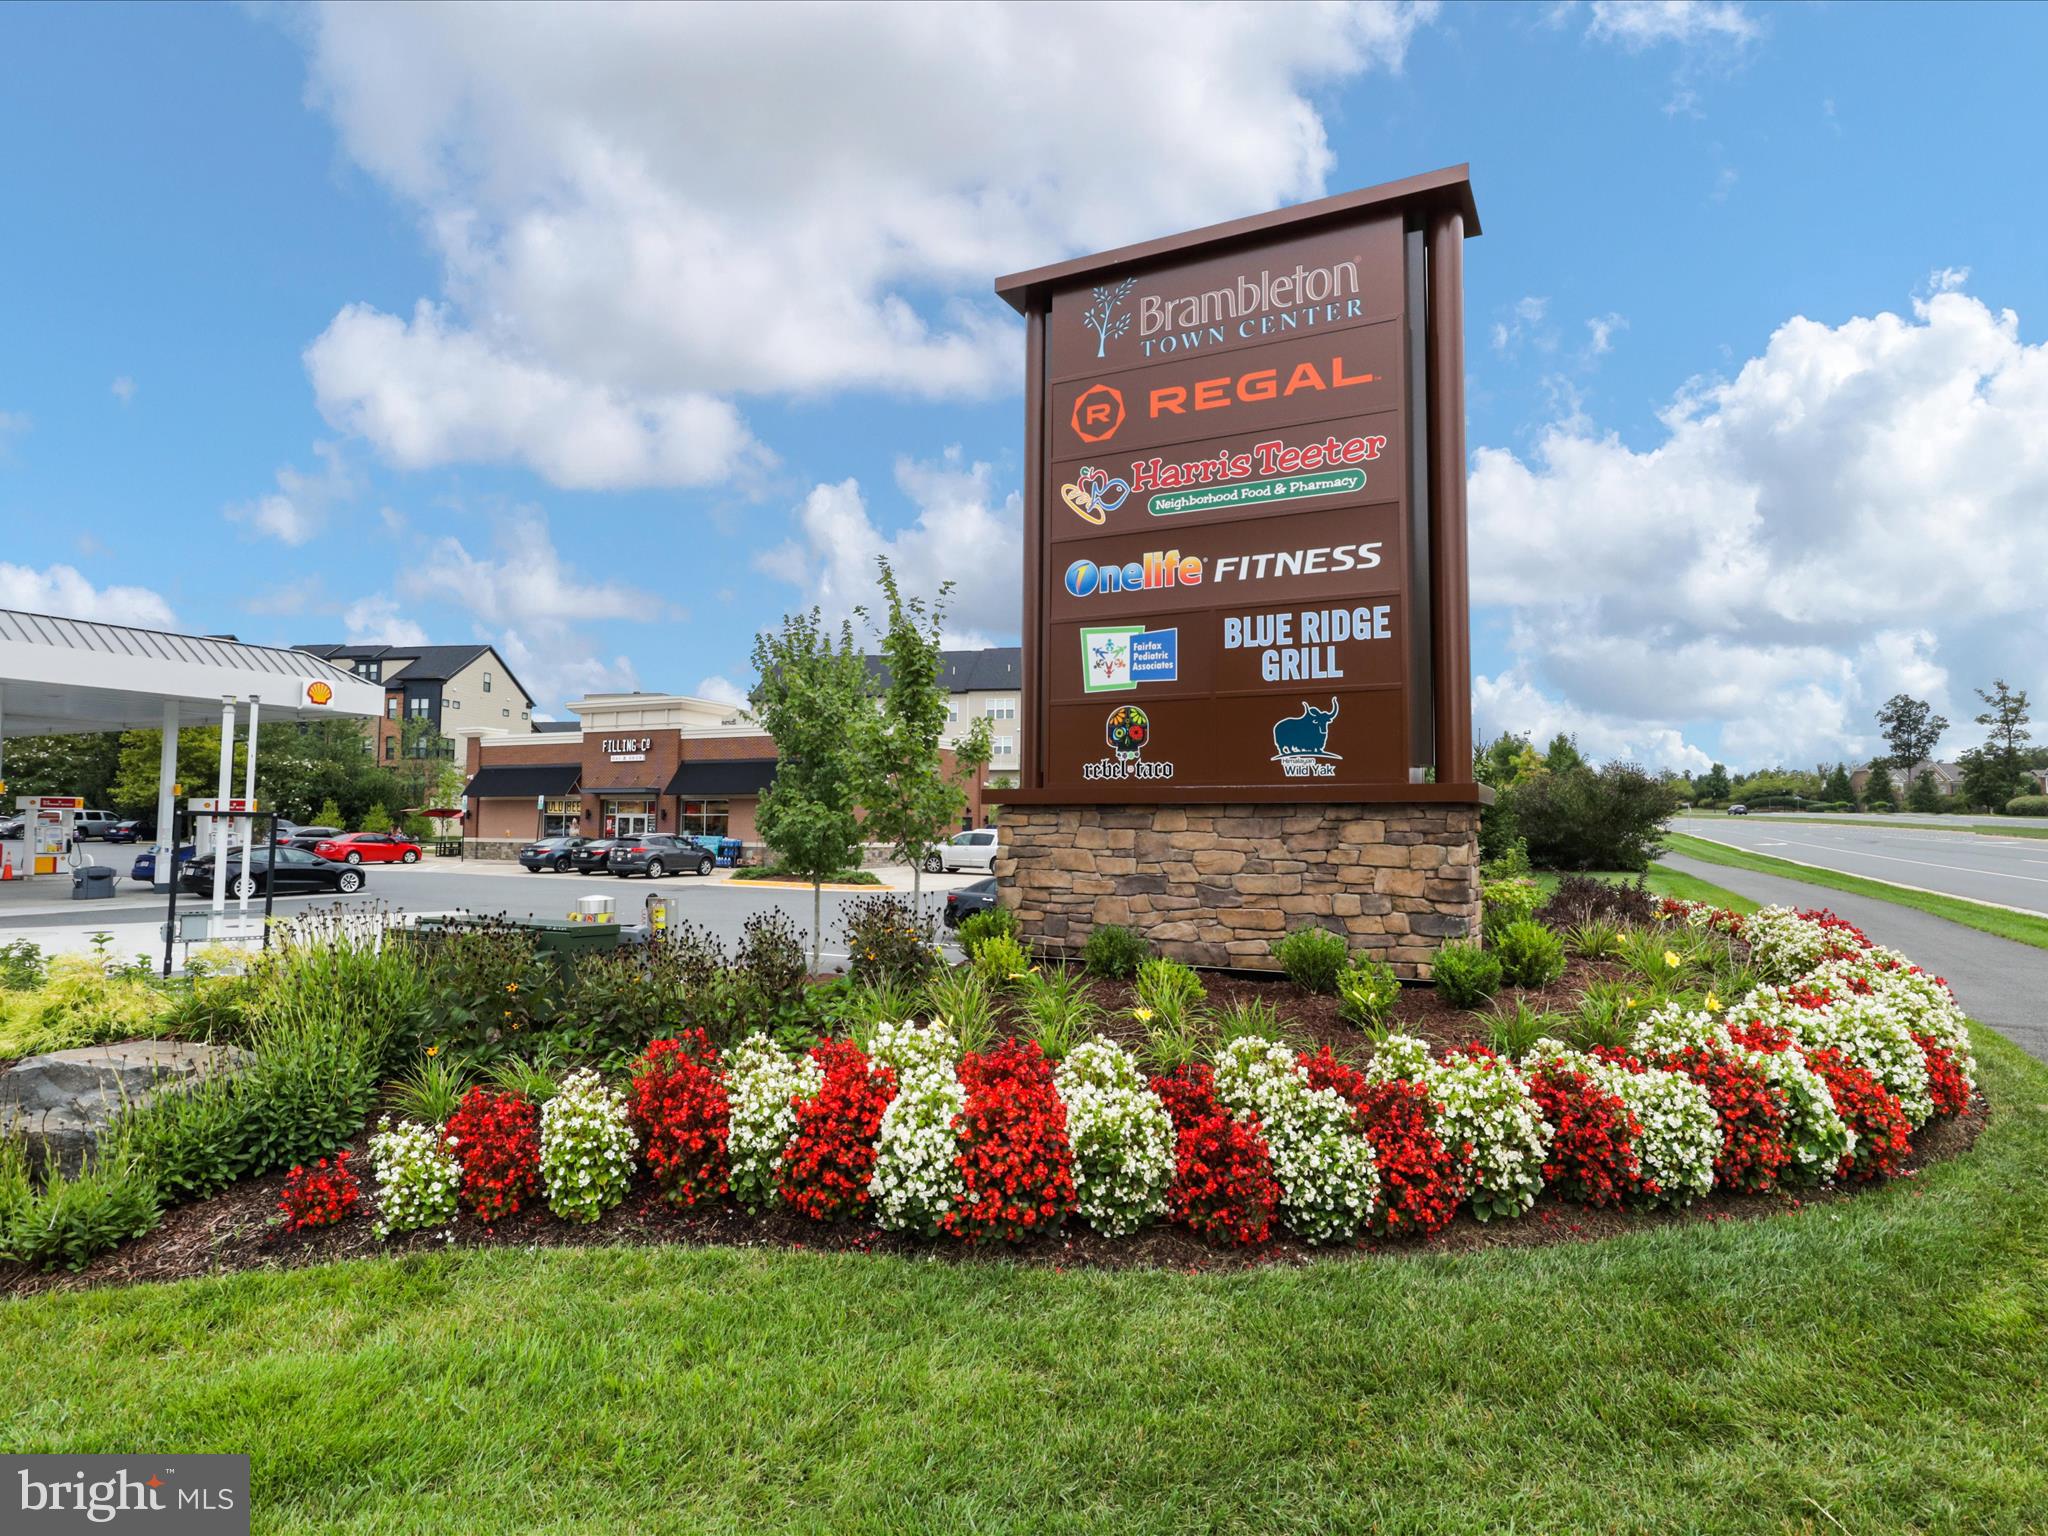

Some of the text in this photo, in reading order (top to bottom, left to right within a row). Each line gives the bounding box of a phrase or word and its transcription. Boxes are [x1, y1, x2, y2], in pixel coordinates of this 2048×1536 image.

[1140, 261, 1360, 336] Brambleton
[1140, 299, 1363, 357] TOWN CENTER
[1149, 356, 1374, 419] REGAL
[1131, 434, 1387, 493] Harris Teeter
[1155, 475, 1358, 511] Neighborhood Food & Pharmacy
[1213, 542, 1383, 583] FITNESS
[1224, 605, 1392, 649] BLUE RIDGE
[1133, 641, 1162, 651] Fairfax
[1133, 650, 1169, 661] Pediatric
[1261, 646, 1344, 682] GRILL
[1132, 660, 1174, 671] Associates
[602, 738, 637, 752] FILLING
[1083, 758, 1174, 780] rebel taco
[1284, 764, 1335, 776] Wild Yak
